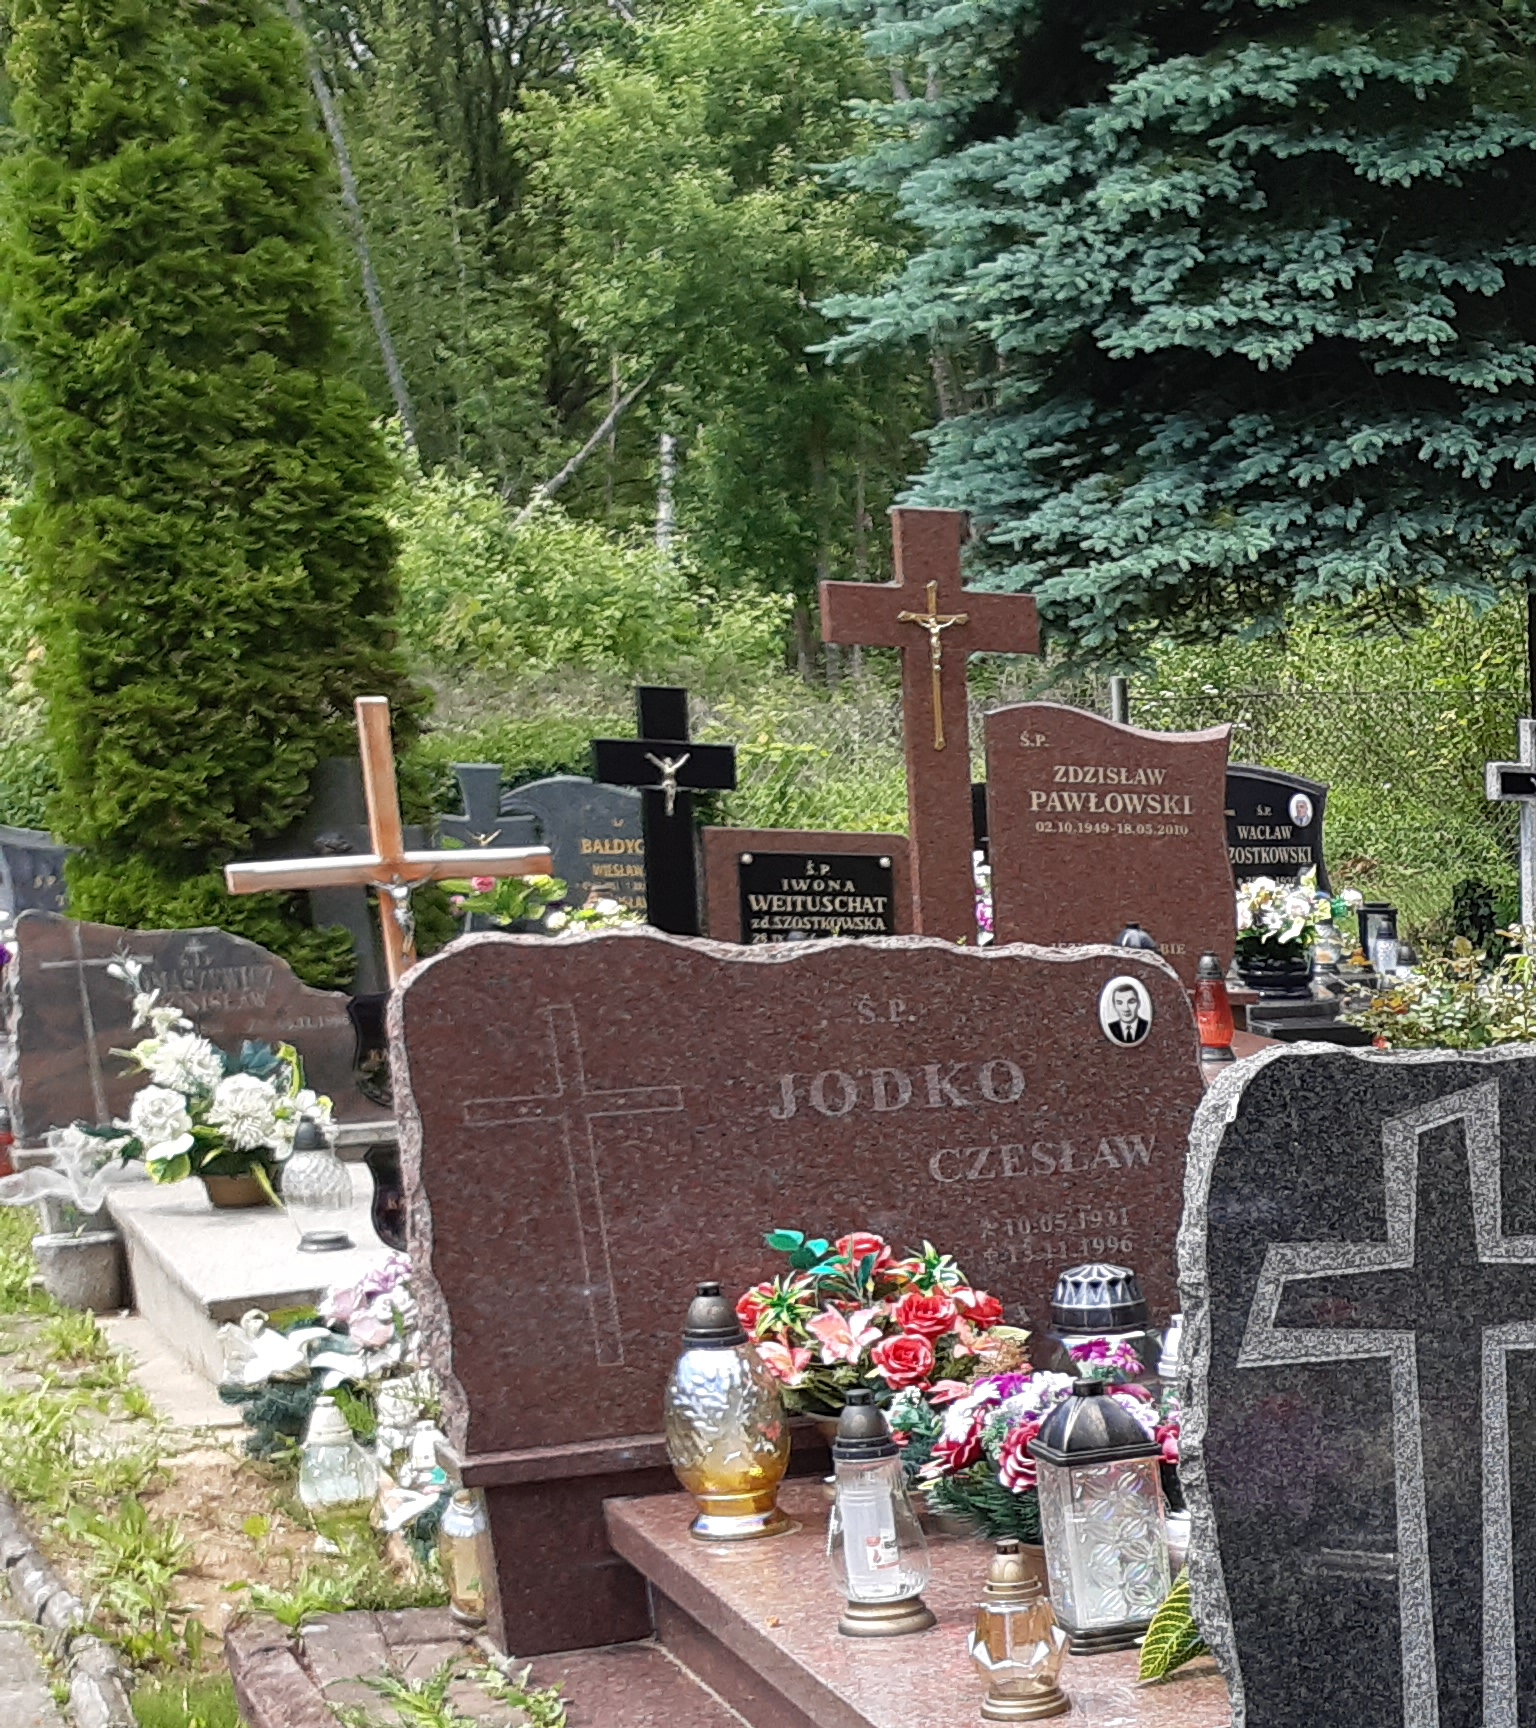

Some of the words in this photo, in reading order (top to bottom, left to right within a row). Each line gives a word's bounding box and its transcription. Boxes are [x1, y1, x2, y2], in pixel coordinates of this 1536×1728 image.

[1019, 731, 1050, 748] Ś.P.
[1053, 765, 1167, 786] ZDZISŁAW
[1029, 791, 1193, 816] PAWŁOWSKI
[1237, 825, 1293, 840] WACŁAW
[781, 879, 855, 893] IWONA
[748, 894, 888, 913] WEITUSCHAT
[769, 1058, 1027, 1120] JODKO
[928, 1133, 1157, 1183] CZESŁAW
